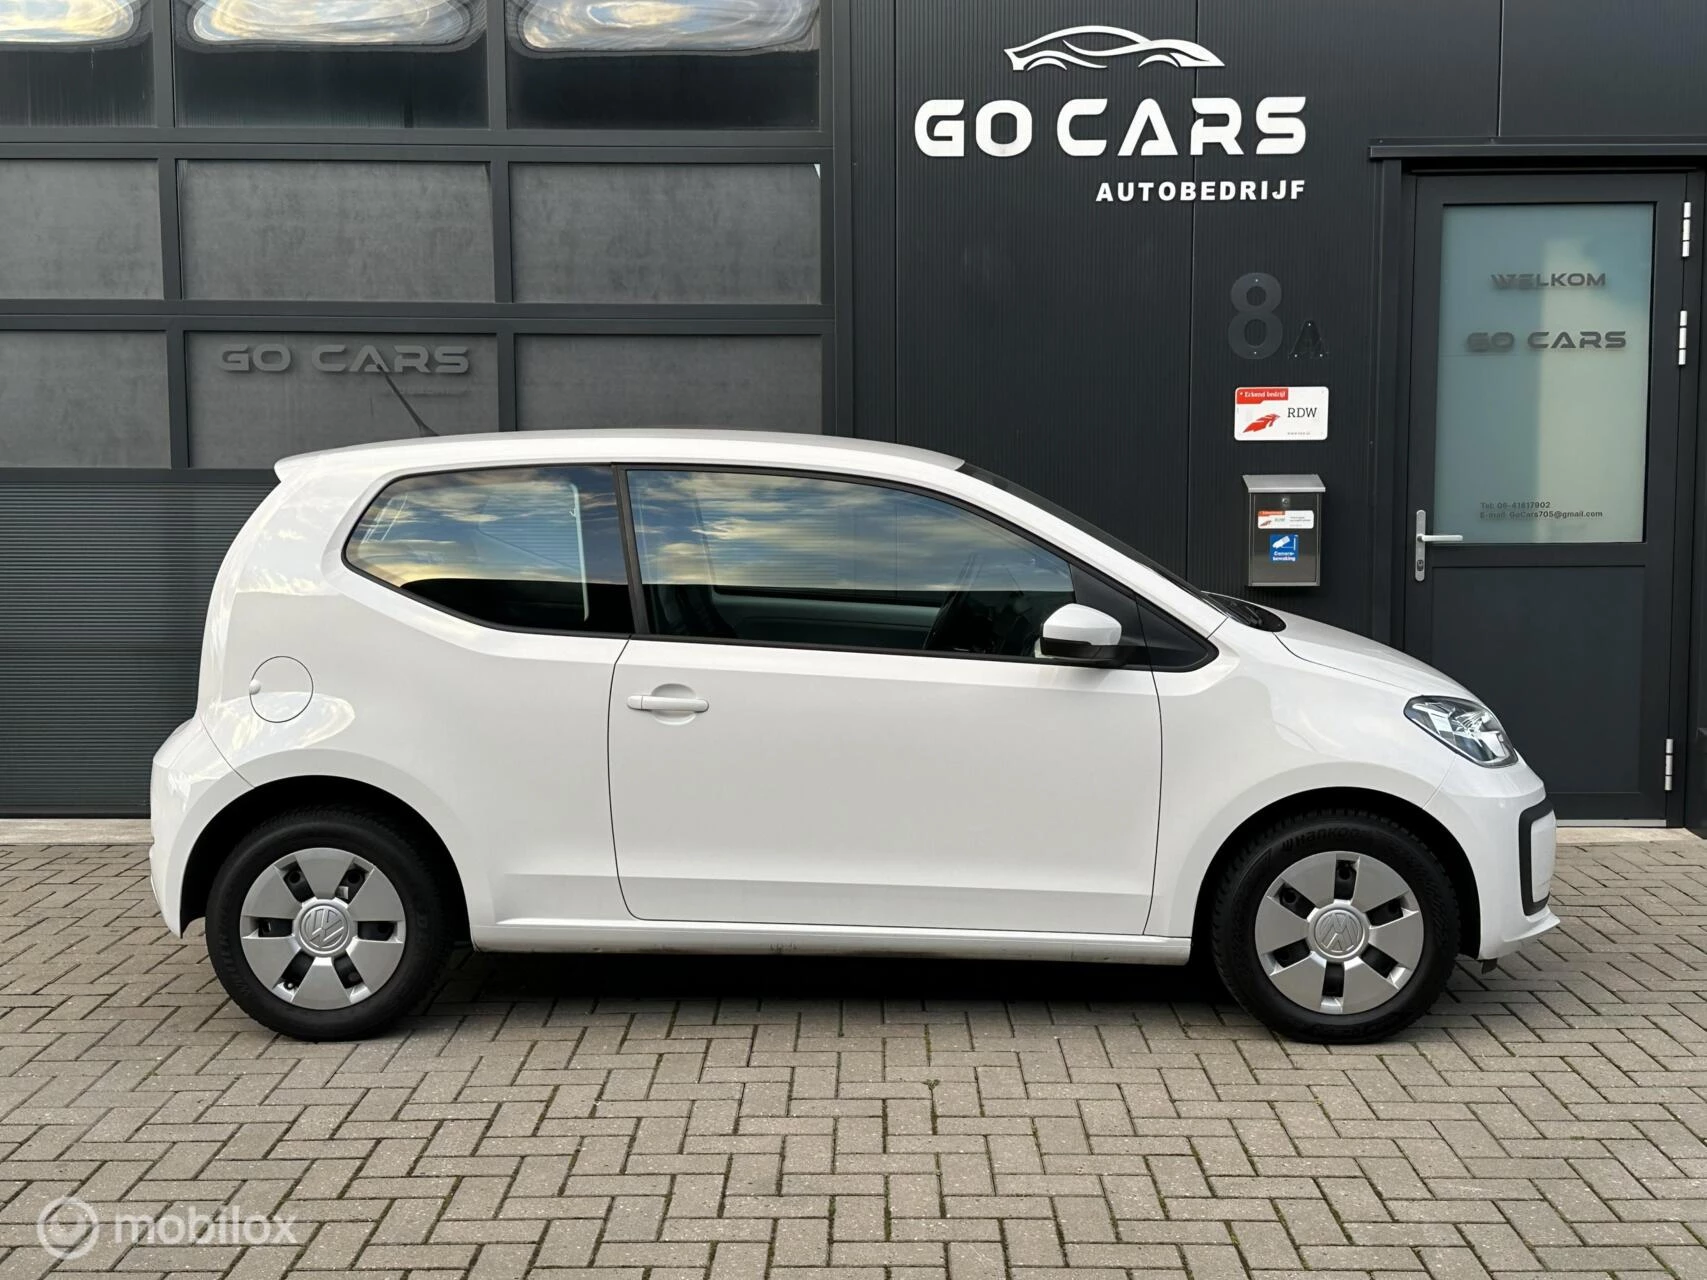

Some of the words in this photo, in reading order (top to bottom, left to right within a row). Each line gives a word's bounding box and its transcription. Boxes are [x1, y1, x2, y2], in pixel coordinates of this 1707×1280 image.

[915, 99, 1032, 157] GO
[1056, 96, 1306, 156] CARS
[1095, 180, 1305, 202] AUTOBEDRIJF
[1491, 273, 1606, 289] WELKOM
[1467, 332, 1514, 351] GO
[1527, 331, 1626, 349] CARS
[219, 344, 291, 372] GO
[311, 344, 469, 373] CARS
[1287, 408, 1317, 418] RDW
